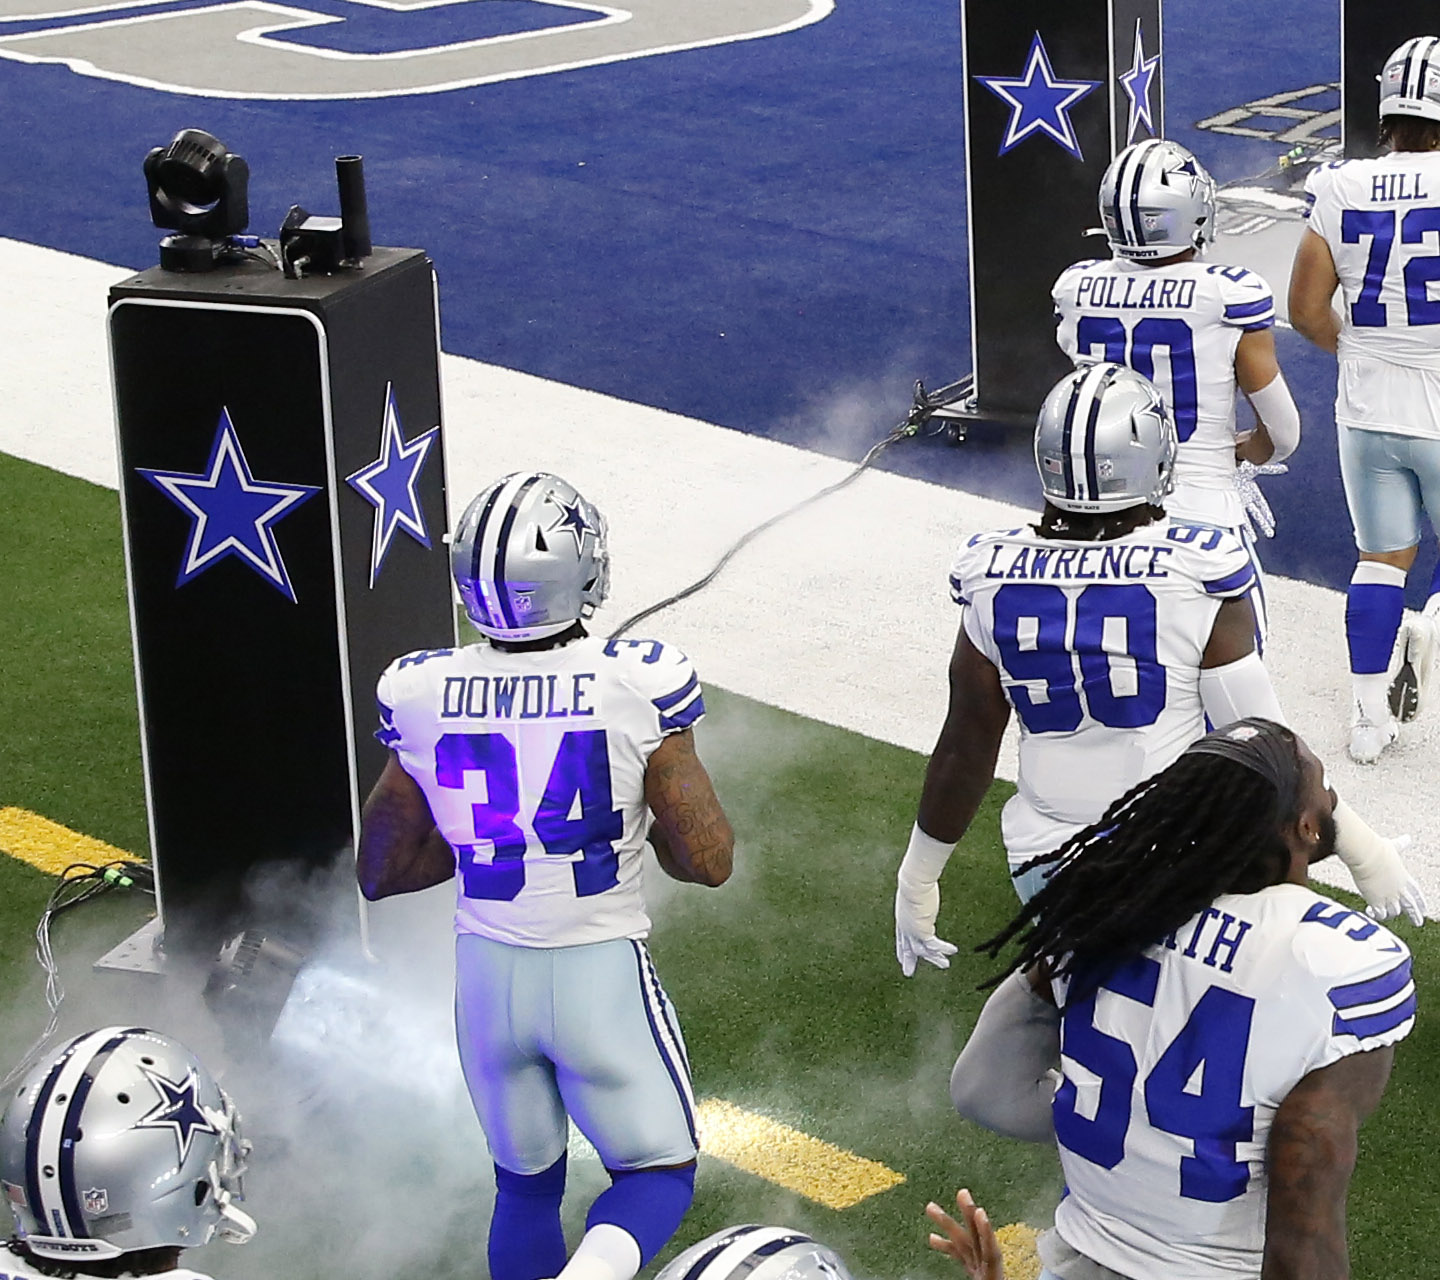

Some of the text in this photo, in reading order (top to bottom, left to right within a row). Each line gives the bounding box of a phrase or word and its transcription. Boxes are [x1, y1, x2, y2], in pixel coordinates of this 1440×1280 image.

[1370, 173, 1428, 202] HILL
[1075, 276, 1195, 310] POLLARD
[984, 543, 1174, 580] LAWRENCE
[993, 582, 1168, 734] 90
[440, 673, 596, 719] DOWDLE
[435, 728, 625, 902] 34
[1051, 950, 1258, 1203] 54
